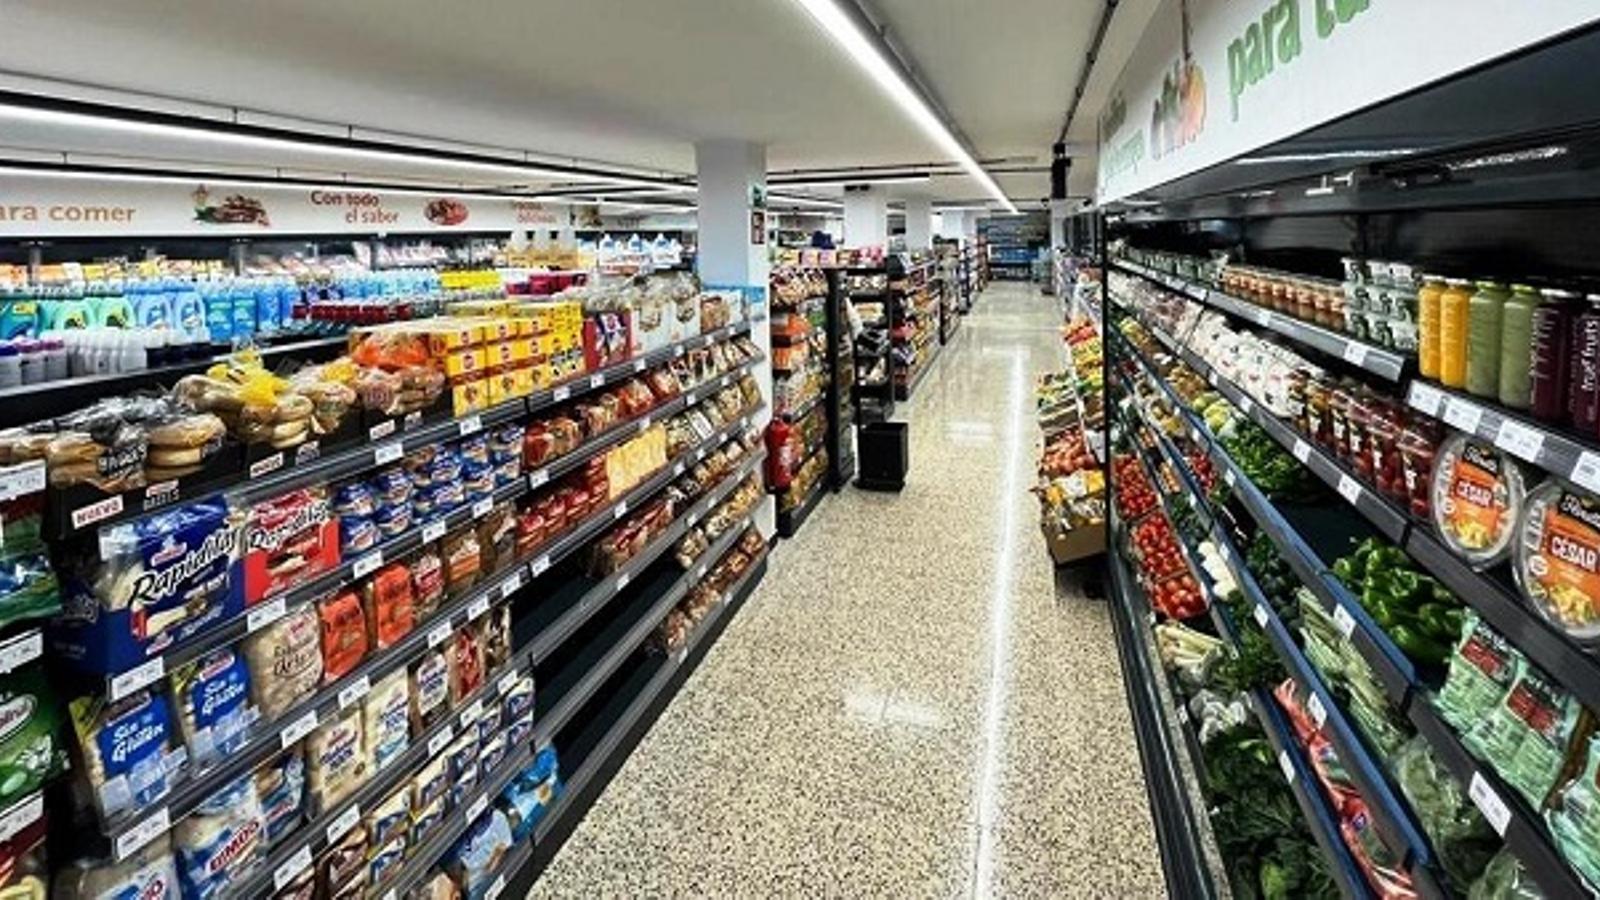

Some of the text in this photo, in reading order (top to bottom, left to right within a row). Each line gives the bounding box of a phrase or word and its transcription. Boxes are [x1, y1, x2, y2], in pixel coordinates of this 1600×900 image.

[1227, 0, 1302, 122] para
[311, 190, 341, 205] Con
[48, 205, 136, 221] comer
[346, 207, 399, 224] el sabor
[76, 499, 120, 524] NUEVO
[110, 721, 164, 763] Gluten
[111, 721, 139, 745] Sin
[210, 819, 260, 872] BIMBO
